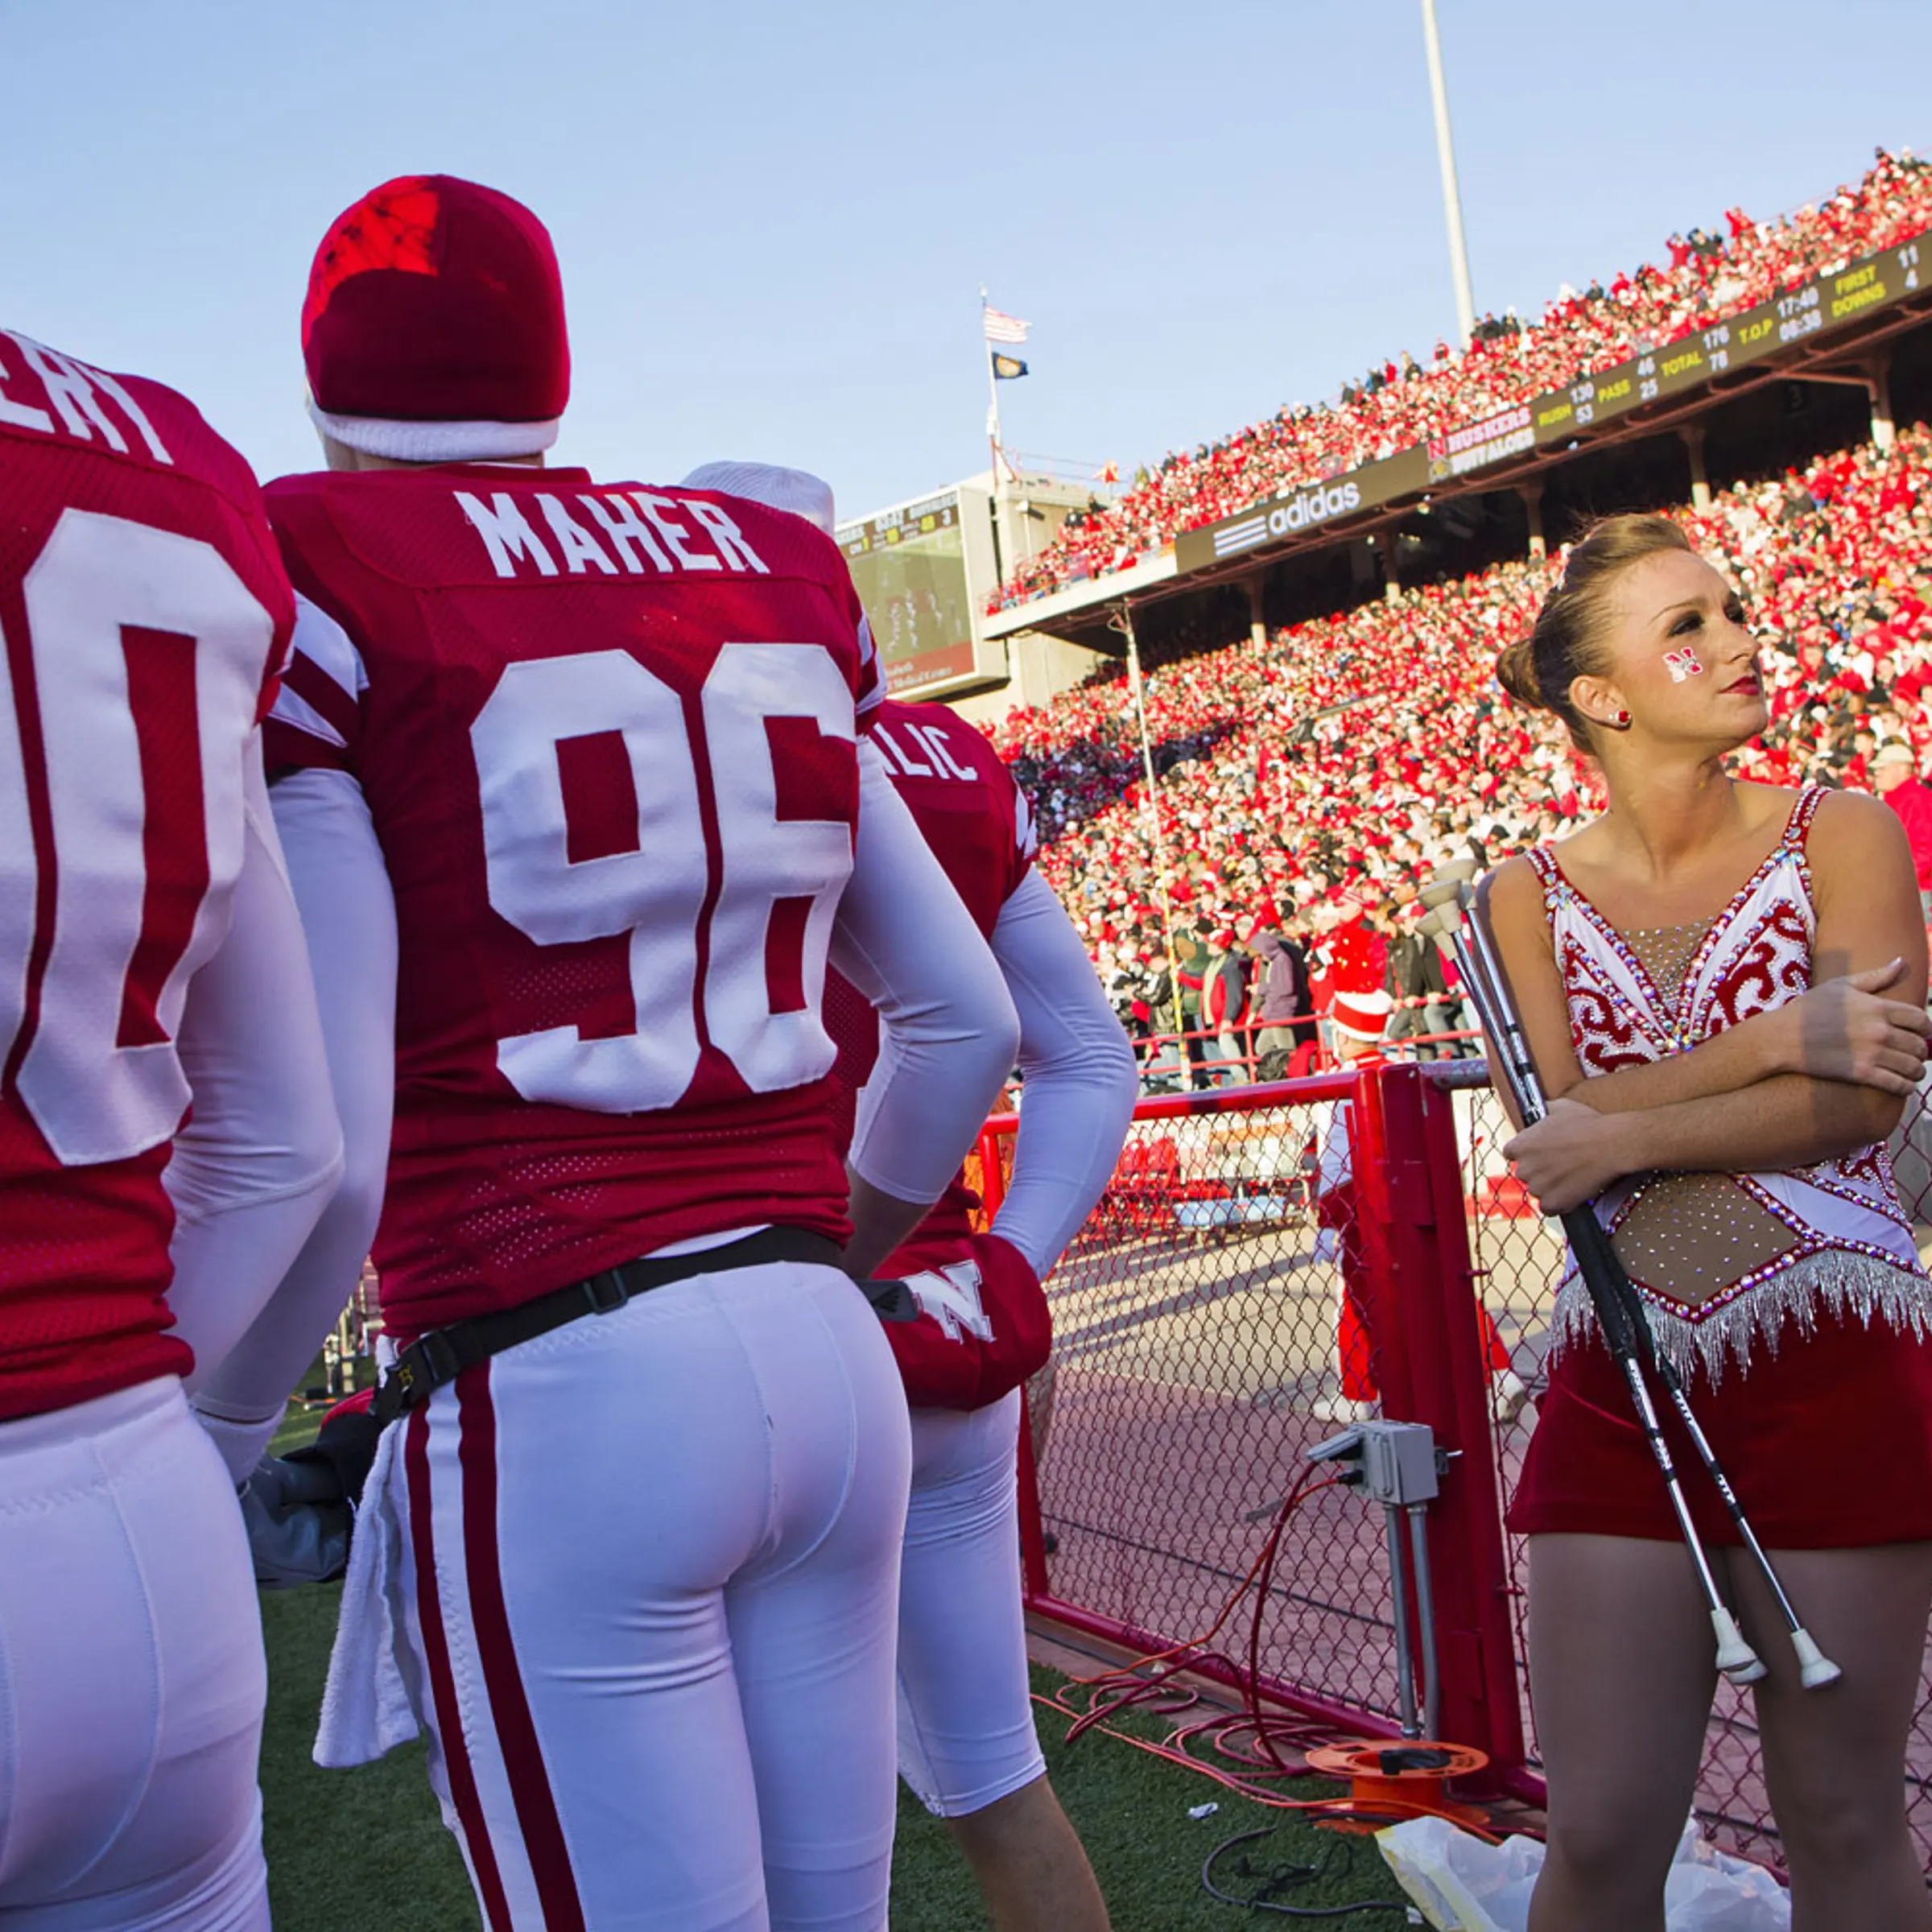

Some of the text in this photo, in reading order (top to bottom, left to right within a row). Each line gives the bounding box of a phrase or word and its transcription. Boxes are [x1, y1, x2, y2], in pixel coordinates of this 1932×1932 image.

[1898, 245, 1918, 268] 11
[1835, 264, 1876, 295] FIRST
[1905, 268, 1918, 289] 4
[1831, 282, 1886, 318] DOWNS
[1703, 325, 1730, 350] 176
[1662, 351, 1703, 377] TOTAL
[1709, 349, 1728, 372] 78
[1571, 382, 1594, 403] 130
[1598, 378, 1631, 402] PASS
[1538, 403, 1571, 427] RUSH
[1448, 406, 1531, 453] HUSKERS
[1269, 481, 1361, 535] adidas
[452, 489, 770, 578] MAHER
[469, 642, 858, 1114] 96
[898, 1258, 997, 1346] N
